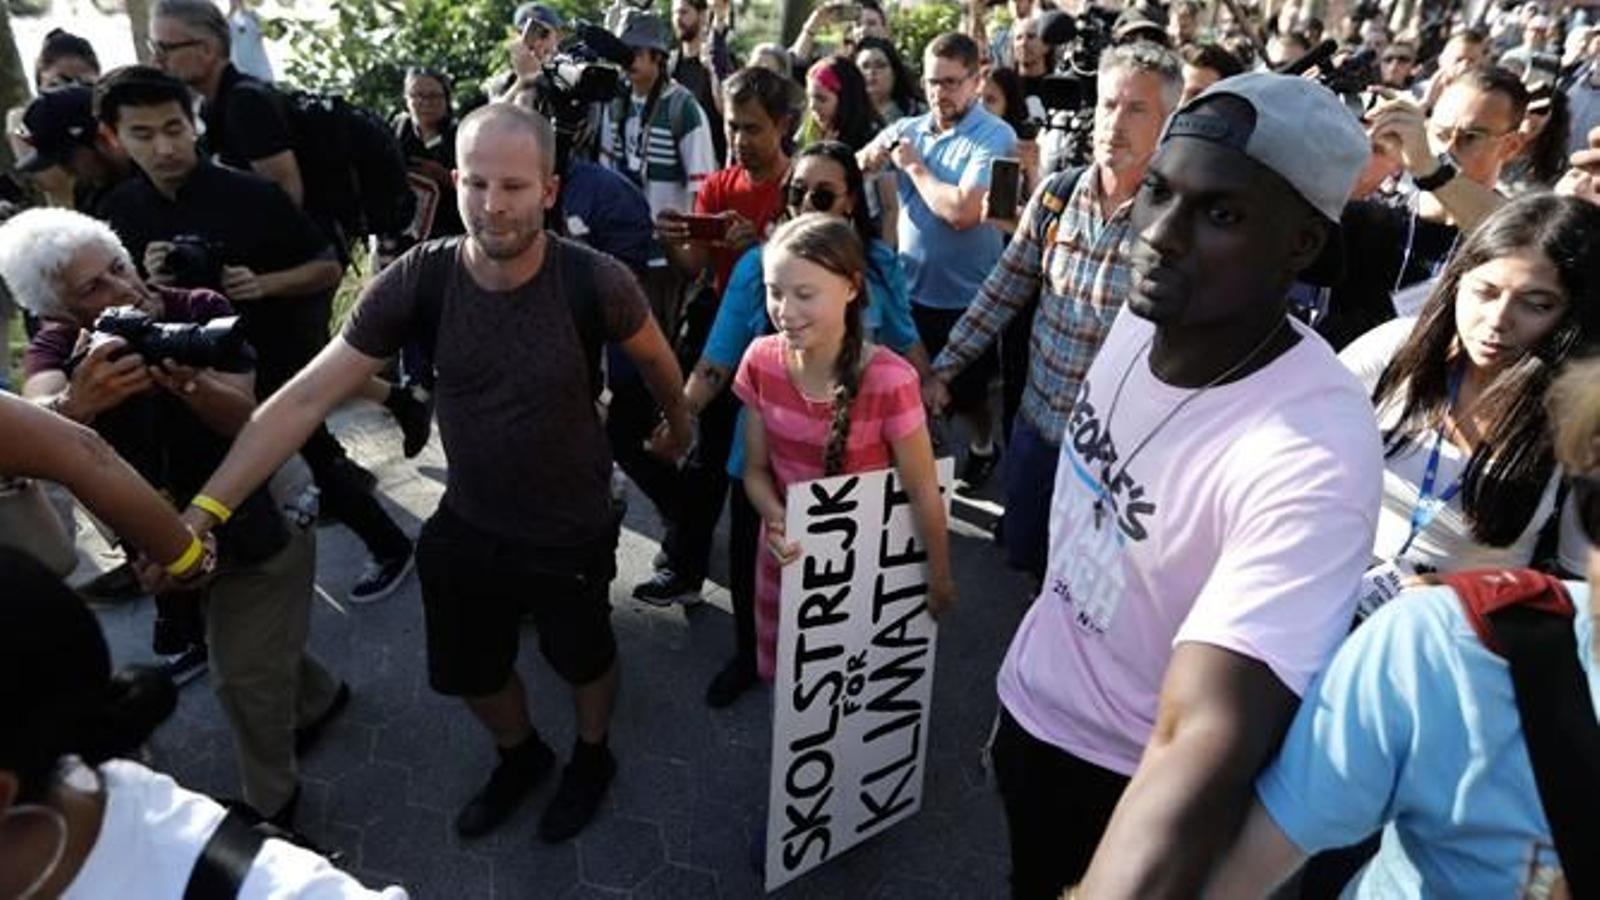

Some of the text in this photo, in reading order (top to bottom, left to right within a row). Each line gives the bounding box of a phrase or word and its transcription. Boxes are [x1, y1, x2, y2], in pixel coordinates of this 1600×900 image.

[781, 475, 859, 871] SKOLSTREJK
[842, 649, 867, 717] FOR
[855, 472, 945, 833] KLIMATET
